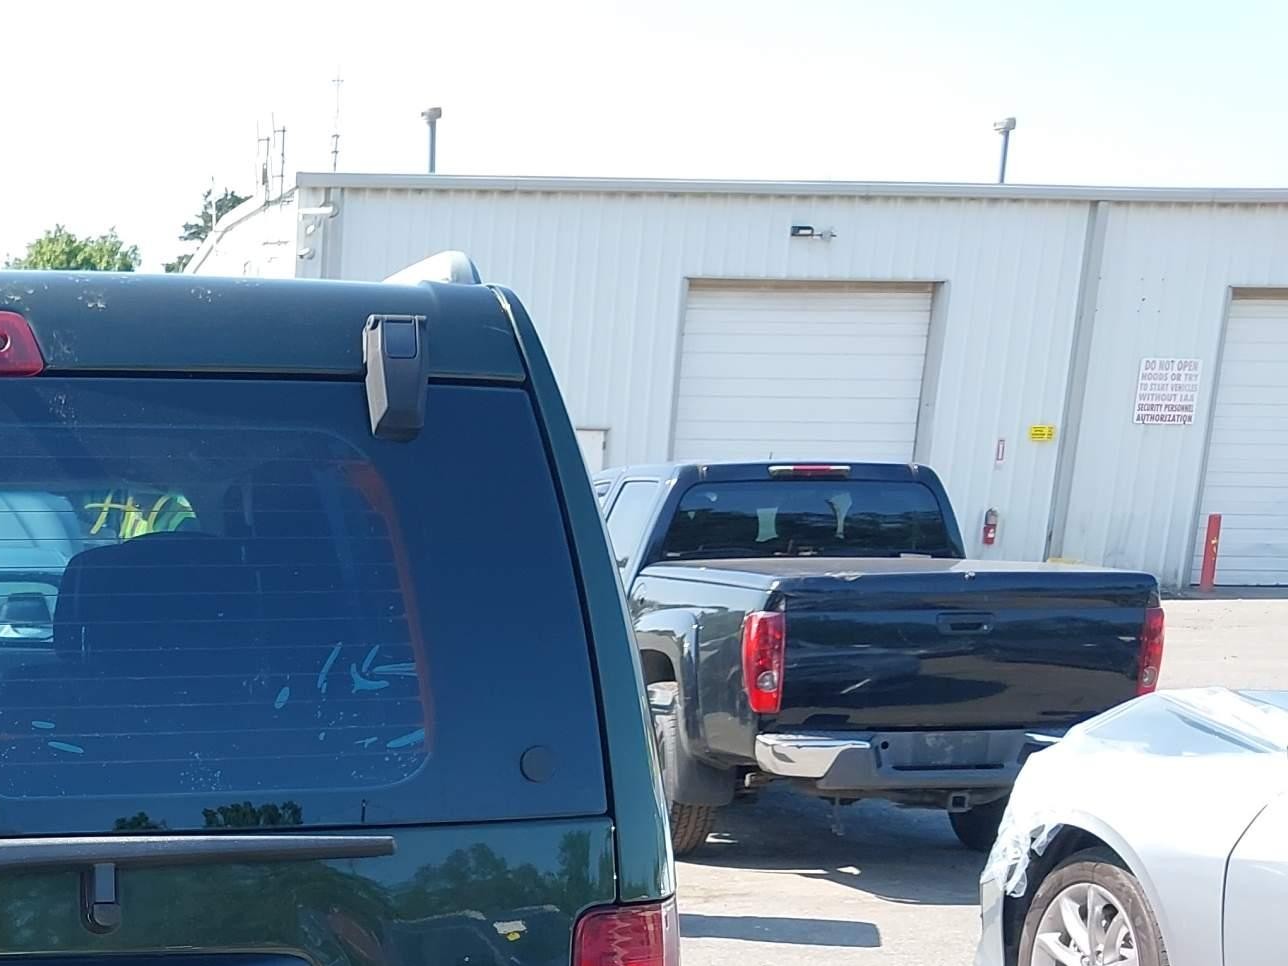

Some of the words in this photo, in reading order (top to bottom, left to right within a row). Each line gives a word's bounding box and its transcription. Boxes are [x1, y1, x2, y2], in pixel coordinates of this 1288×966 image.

[1144, 360, 1157, 371] DO
[1159, 360, 1175, 371] NOT
[1177, 360, 1199, 371] OPEN
[1141, 372, 1168, 381] HOODS
[1170, 372, 1182, 381] OR
[1184, 373, 1199, 381] TRY
[1139, 383, 1148, 391] TO
[1149, 383, 1169, 391] START
[1171, 383, 1198, 392] VEHICLES
[1138, 393, 1177, 402] WITHOUT
[1137, 403, 1163, 411] SECURITY
[1164, 404, 1194, 412] PERSONNEL
[1135, 413, 1193, 422] AUTHORIZATION
